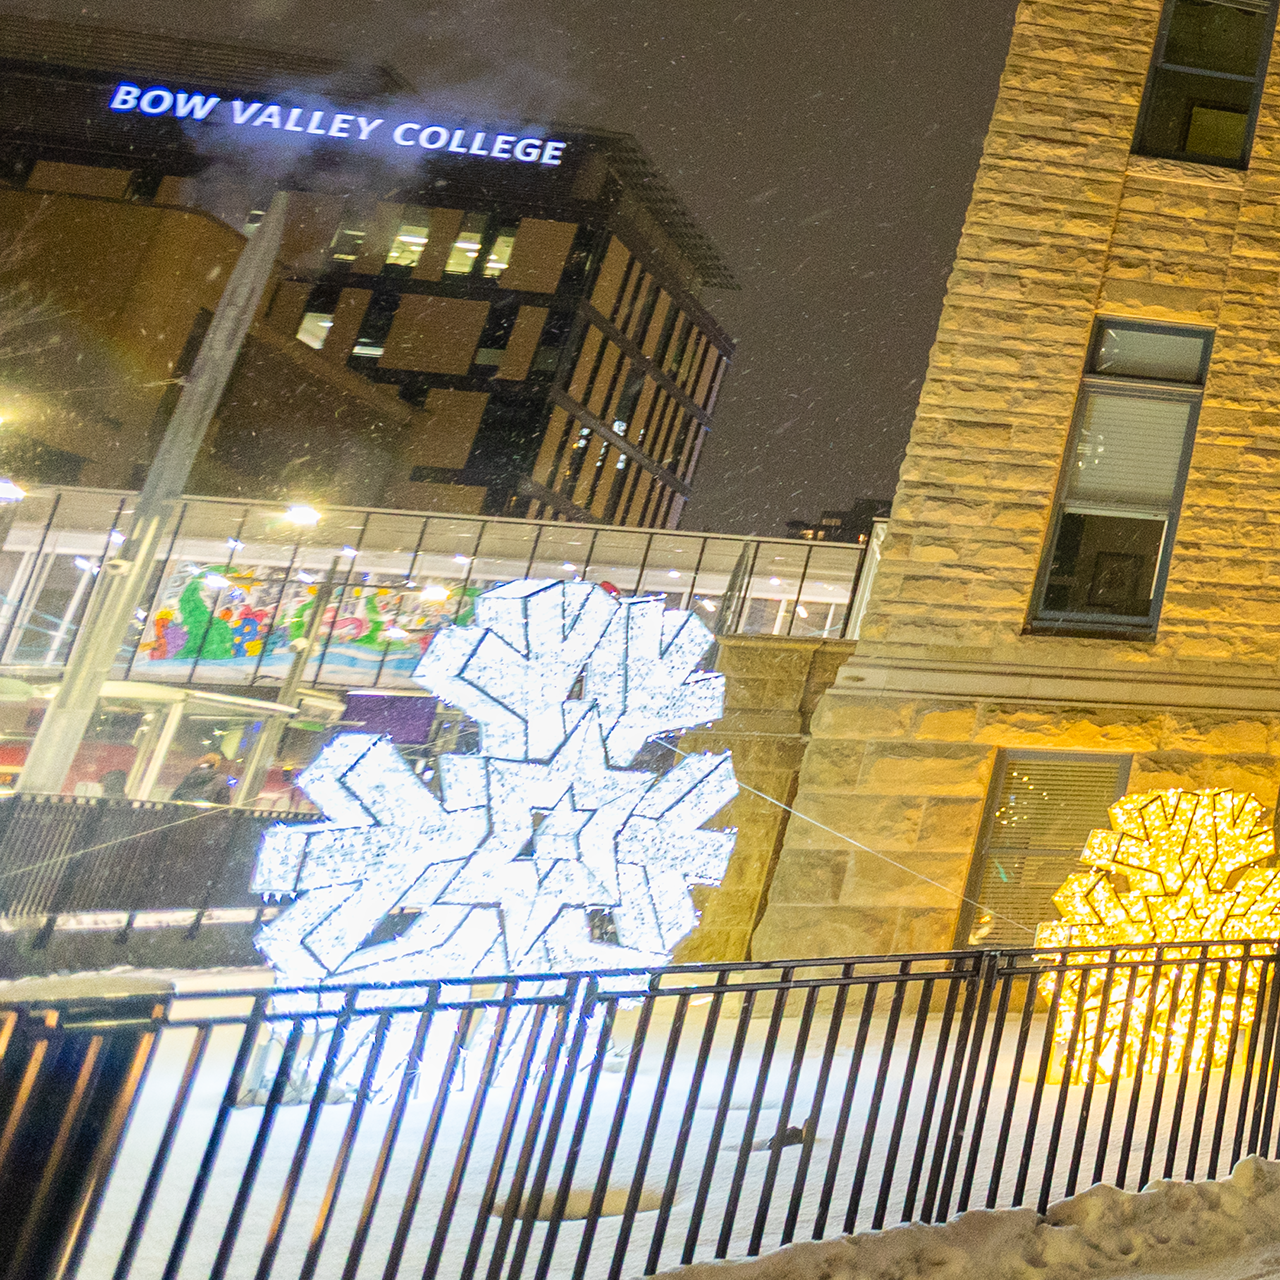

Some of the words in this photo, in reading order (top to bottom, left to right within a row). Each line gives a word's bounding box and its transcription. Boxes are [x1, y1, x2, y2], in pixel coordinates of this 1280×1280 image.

[109, 82, 221, 121] BOW
[231, 98, 384, 140] VALLEY
[393, 122, 567, 165] COLLEGE
